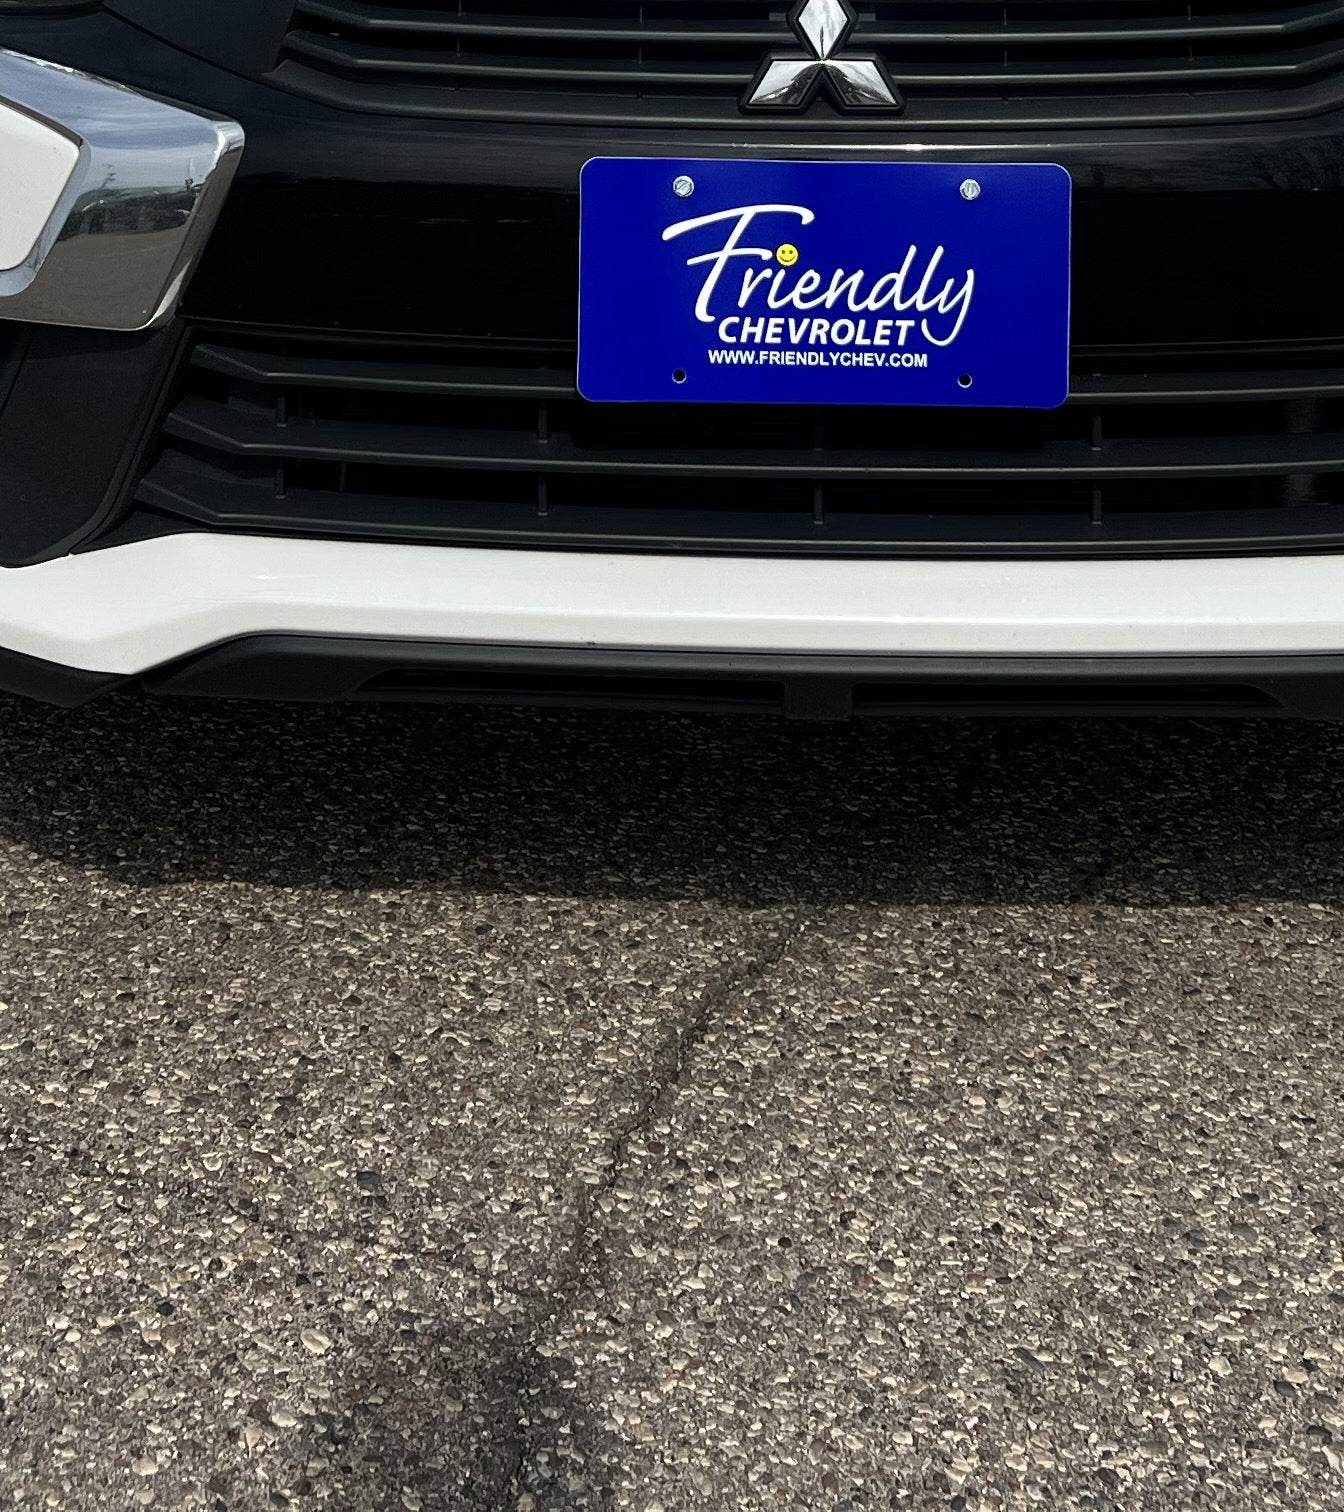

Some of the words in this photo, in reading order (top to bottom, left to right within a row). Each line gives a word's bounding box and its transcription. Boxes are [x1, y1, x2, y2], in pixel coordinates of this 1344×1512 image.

[662, 204, 976, 346] Friendly
[718, 315, 915, 346] CHEVROLET
[708, 349, 928, 367] WWW.FRIENDLYCHEV.COM
